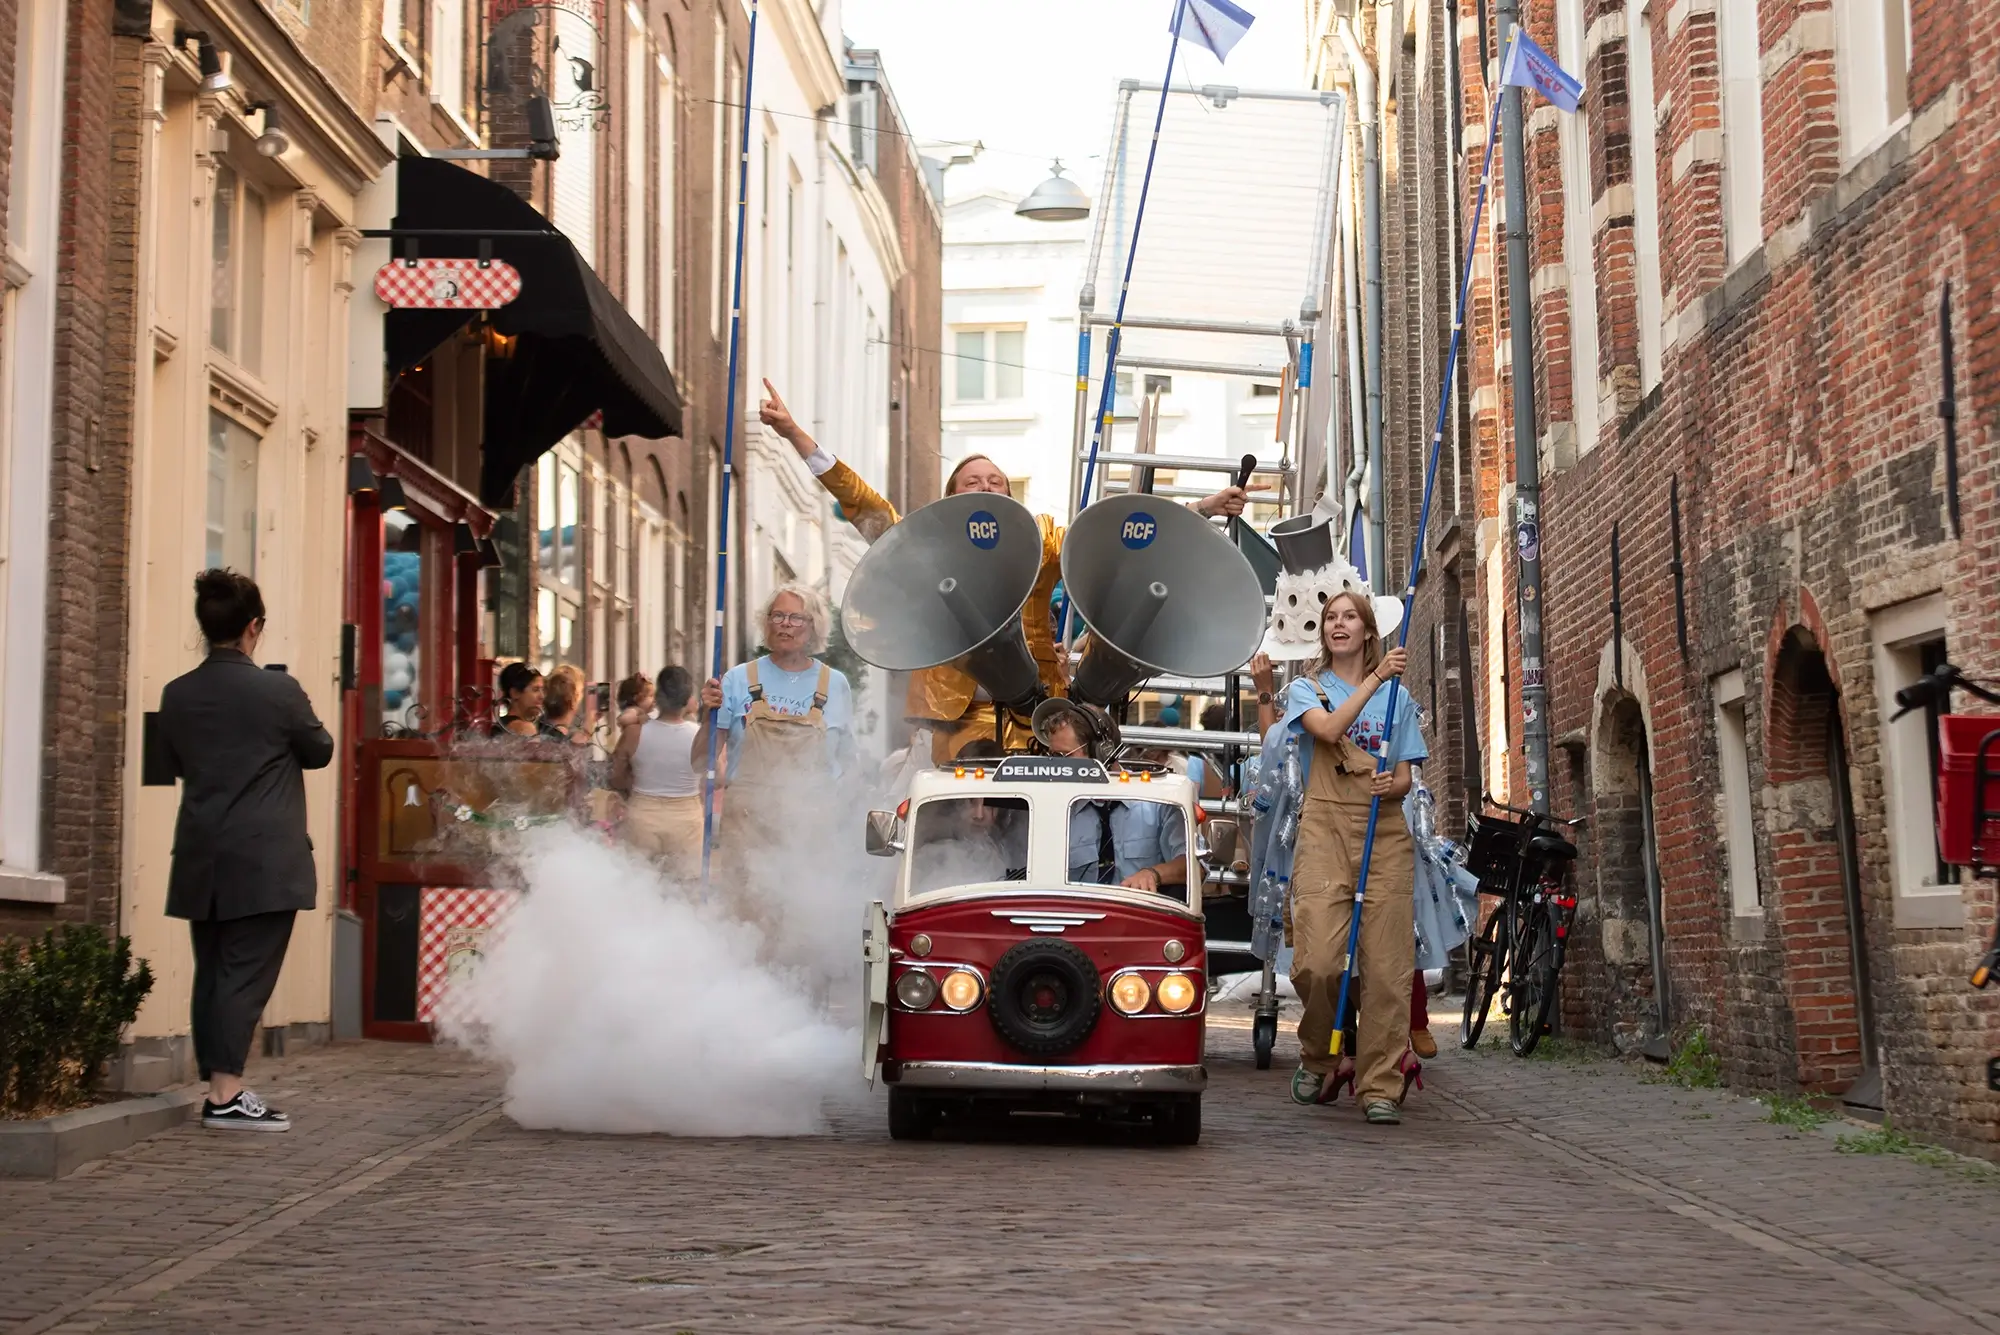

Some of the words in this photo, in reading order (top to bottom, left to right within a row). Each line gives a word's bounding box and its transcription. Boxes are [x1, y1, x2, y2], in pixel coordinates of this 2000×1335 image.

[969, 521, 998, 539] RCF
[1122, 521, 1155, 540] RCF
[1002, 766, 1073, 776] DELINUS
[1077, 767, 1101, 777] 03
